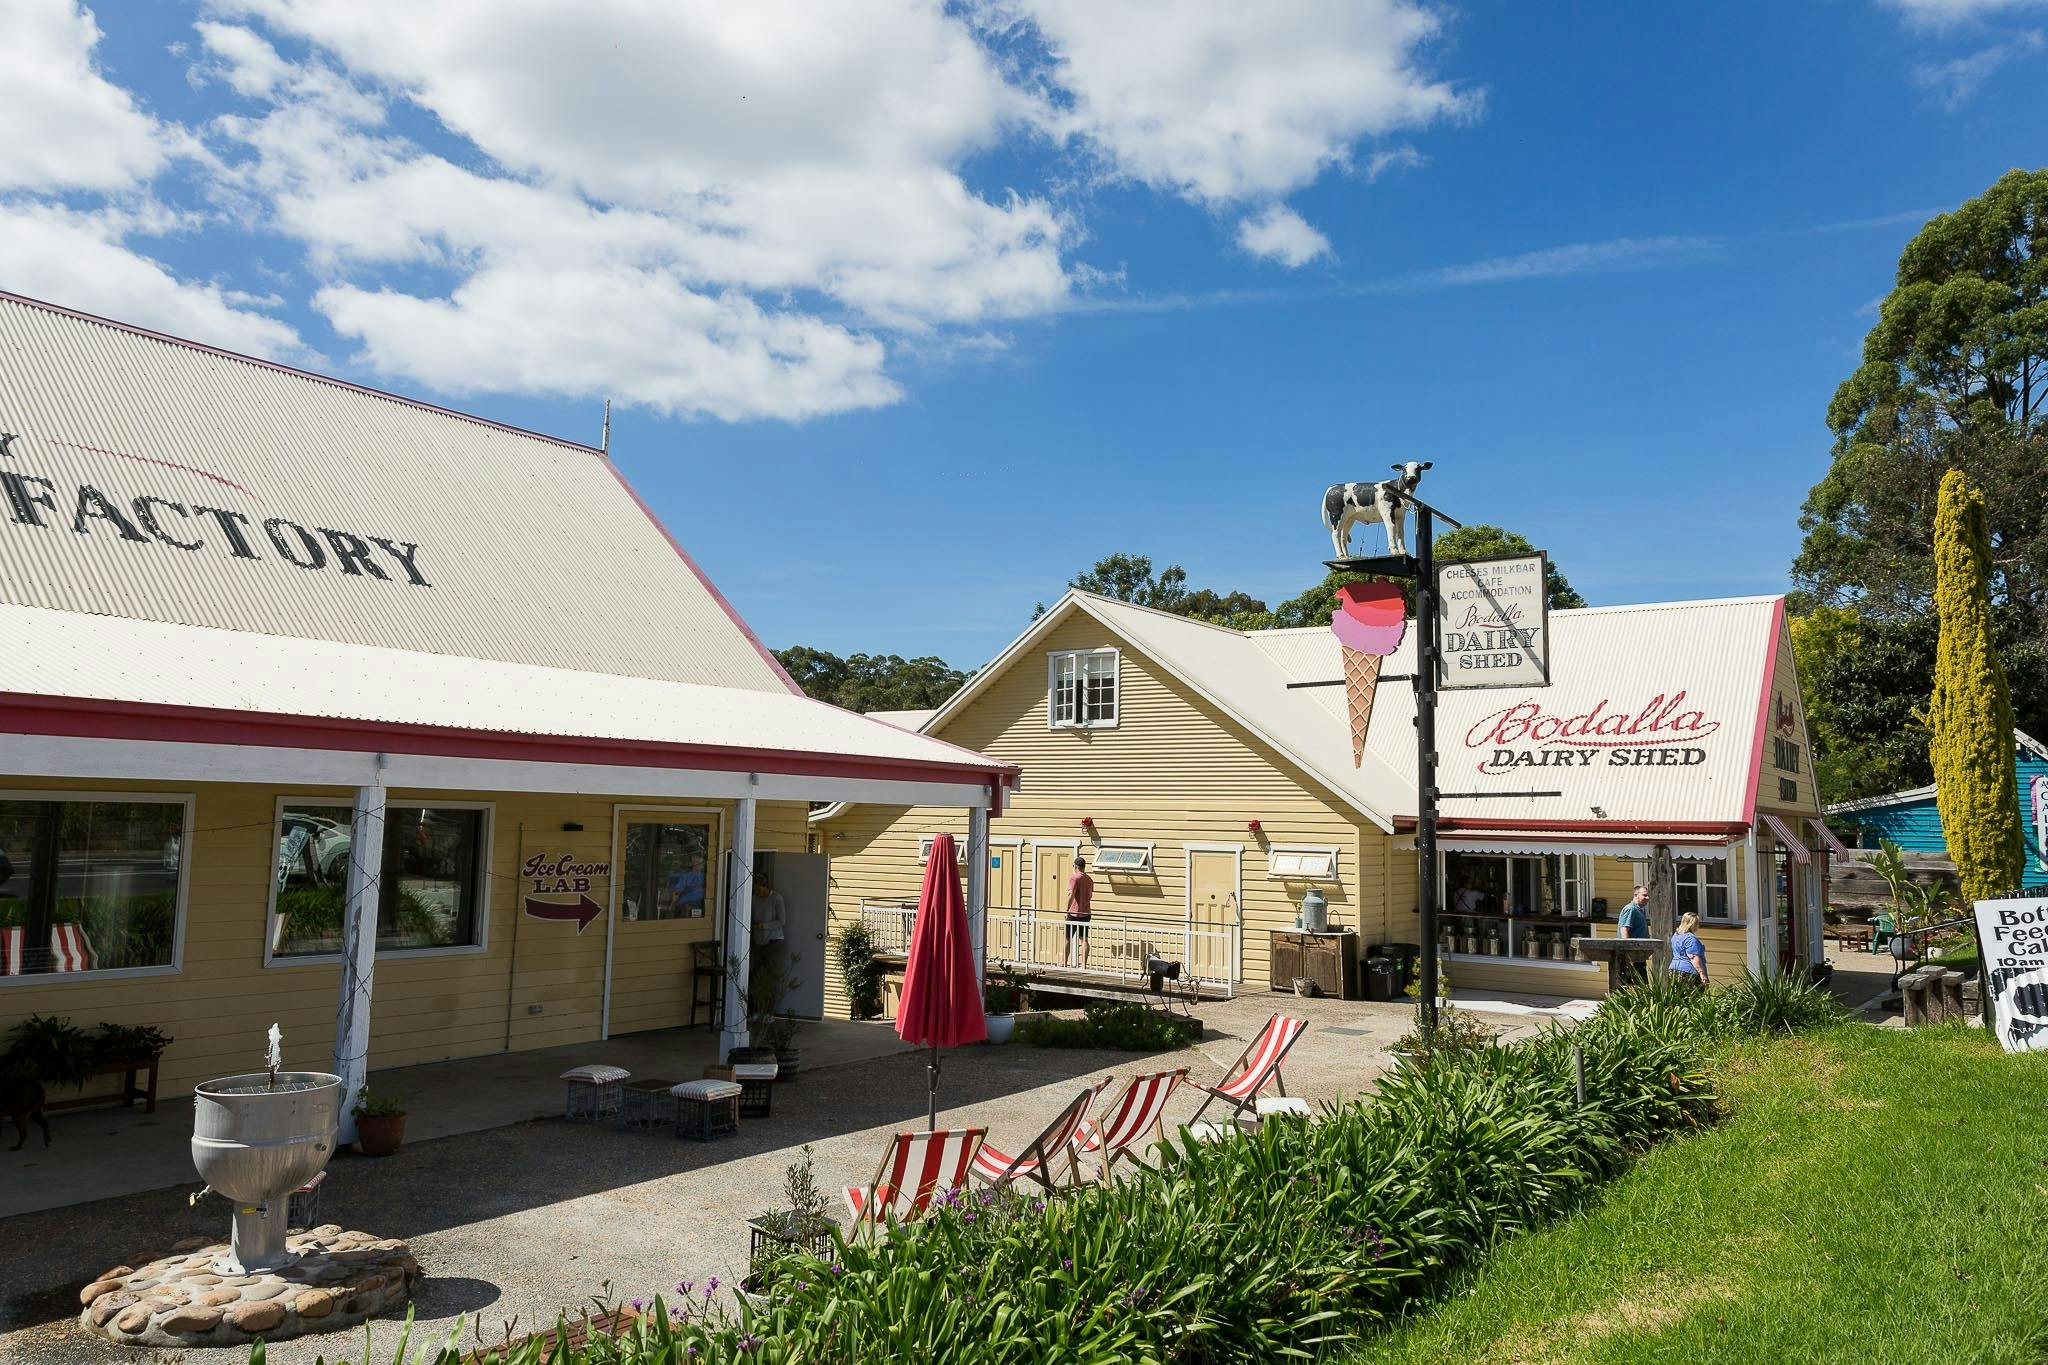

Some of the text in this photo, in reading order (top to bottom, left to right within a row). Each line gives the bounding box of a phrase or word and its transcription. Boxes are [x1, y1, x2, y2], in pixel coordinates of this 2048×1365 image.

[0, 470, 432, 588] FACTORY
[1446, 567, 1489, 580] CHEESES
[1477, 577, 1503, 588] CAFE
[1450, 586, 1532, 601] ACCOMMODATION
[1455, 602, 1525, 630] Bodalla
[1444, 627, 1541, 653] DAIRY
[1459, 652, 1523, 670] SHED
[1465, 690, 1708, 748] Bodalla
[1488, 747, 1707, 767] DAIRY SHED
[532, 878, 591, 894] LAB
[1998, 906, 2048, 925] Bot
